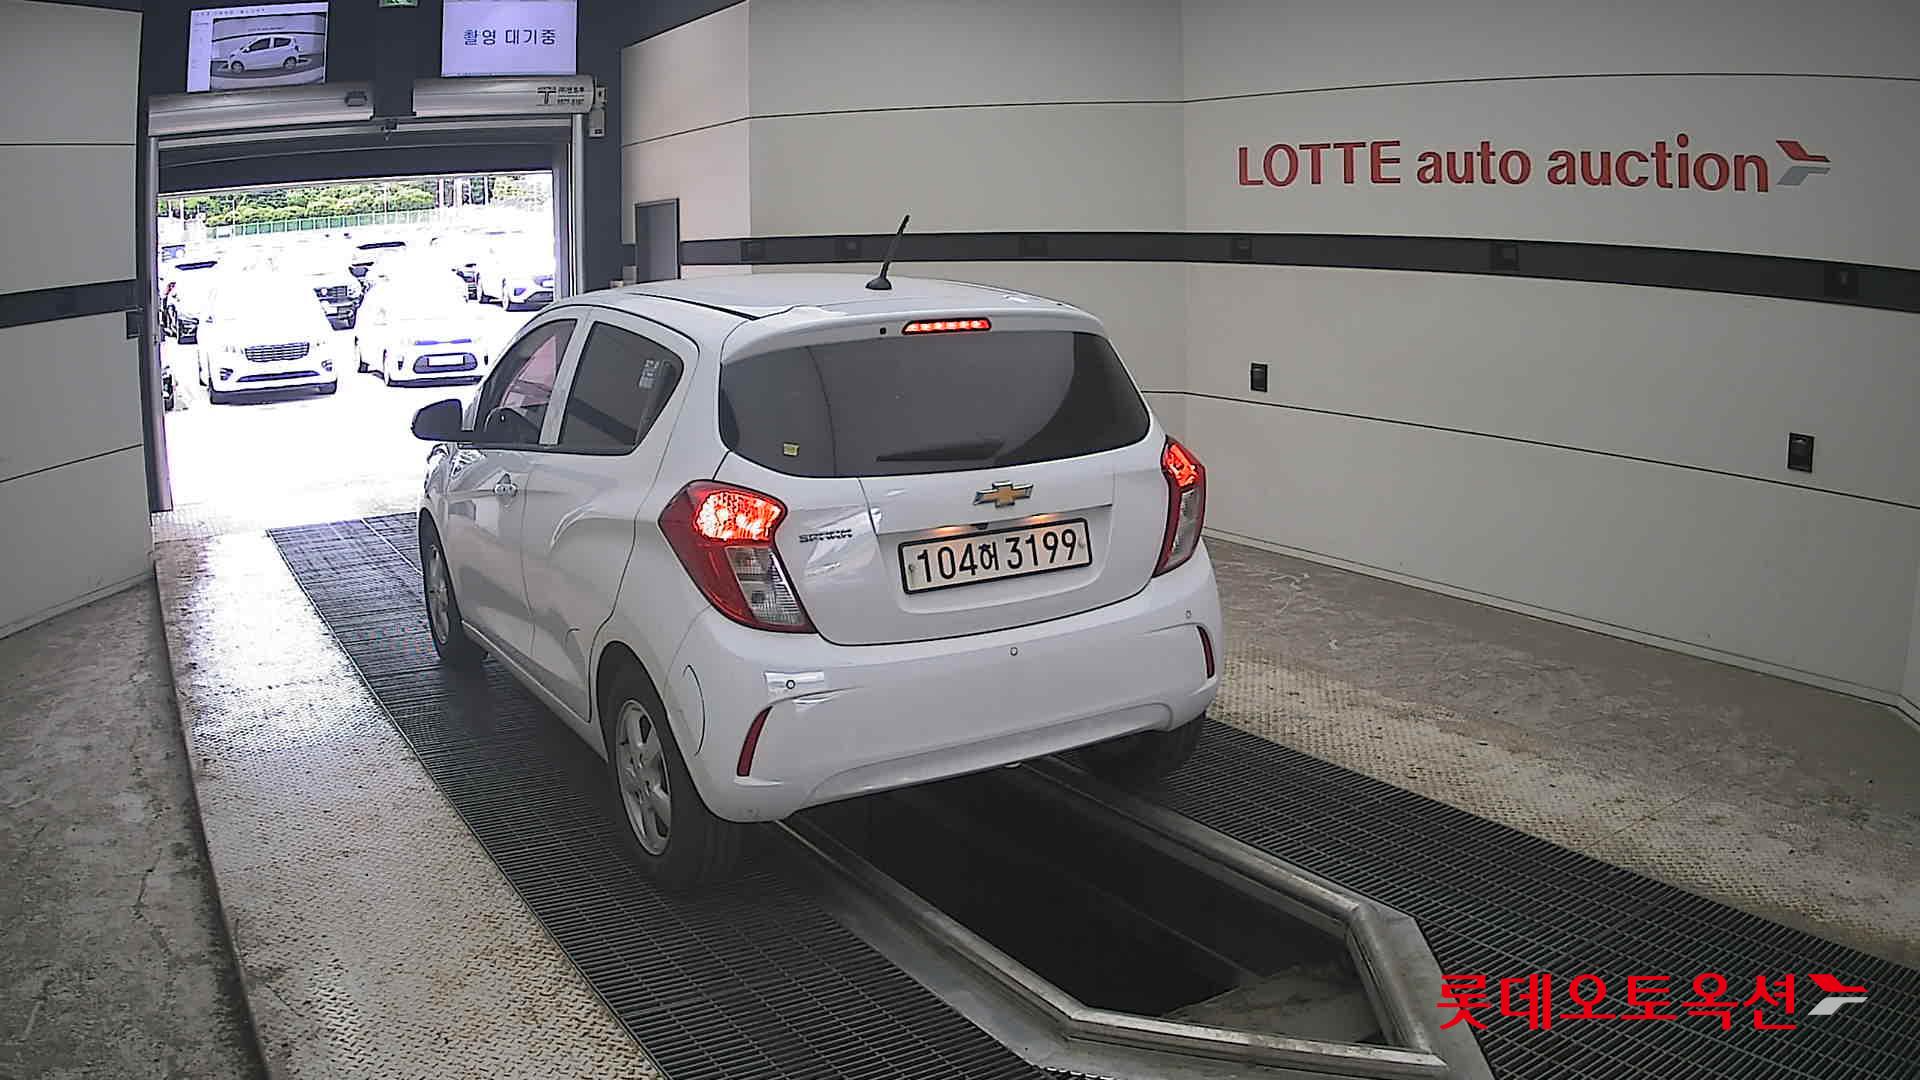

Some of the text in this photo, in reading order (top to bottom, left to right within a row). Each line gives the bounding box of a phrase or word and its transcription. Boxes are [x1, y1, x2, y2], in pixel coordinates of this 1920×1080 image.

[463, 28, 556, 46] 촬영 대기중
[1239, 133, 1769, 193] LOTTE auto auction
